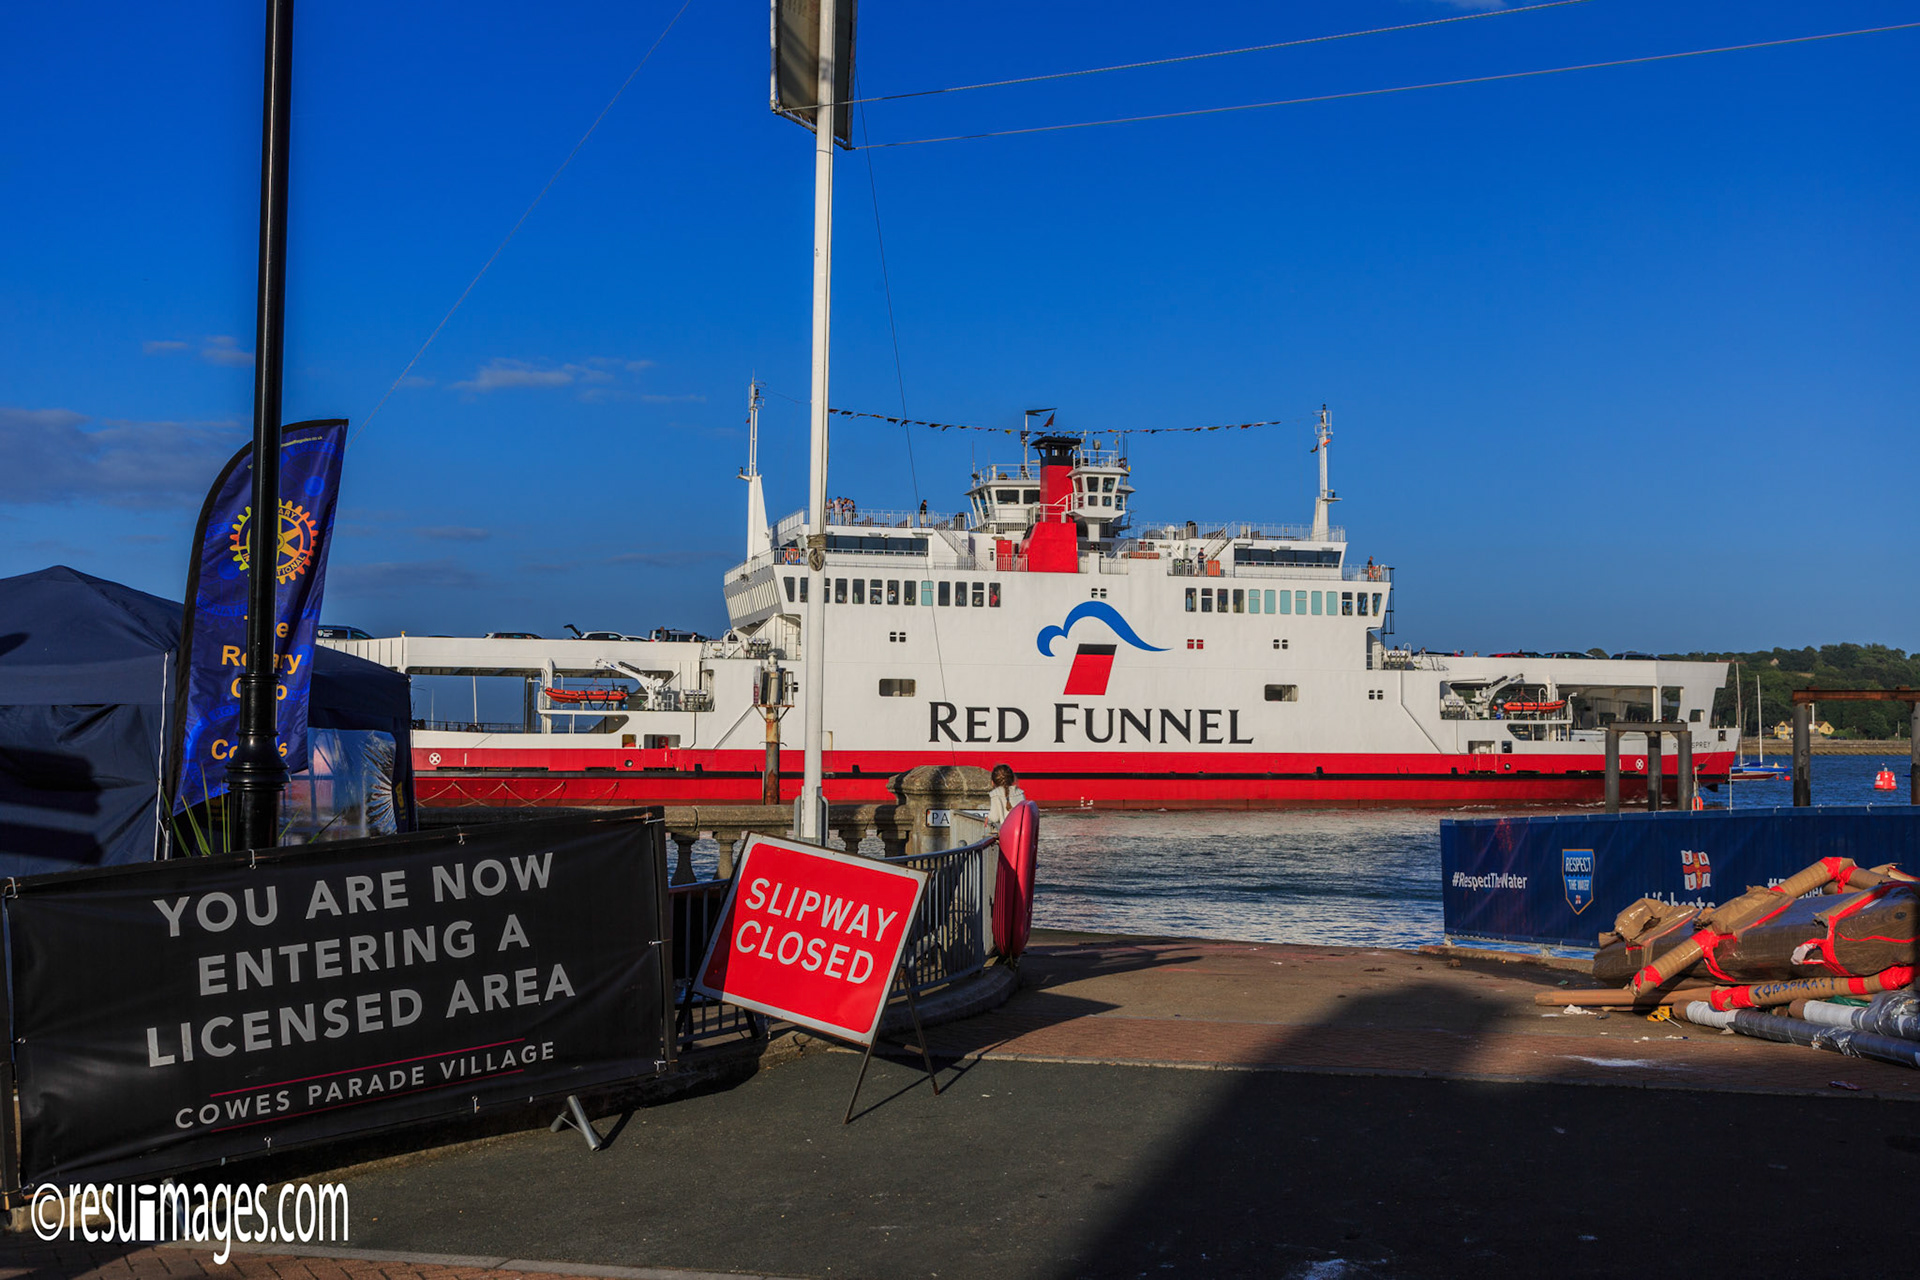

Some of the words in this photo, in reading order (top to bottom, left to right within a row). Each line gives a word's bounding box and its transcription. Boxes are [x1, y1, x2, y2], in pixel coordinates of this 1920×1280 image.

[929, 701, 1030, 743] RED
[1054, 703, 1254, 744] FUNNEL
[153, 886, 279, 938] YOU
[305, 870, 409, 919] ARE
[432, 852, 554, 902] NOW
[1452, 871, 1528, 891] #RespectTheWater
[1565, 857, 1591, 872] RESPECT
[745, 877, 898, 942] SLIPWAY
[198, 919, 475, 997] ENTERING
[497, 914, 530, 952] A
[735, 920, 874, 984] CLOSED
[147, 988, 423, 1067] LICENSED
[445, 964, 576, 1019] AREA
[175, 1090, 290, 1129] COWES
[308, 1065, 425, 1106] PARADE
[440, 1041, 554, 1080] VILLAGE
